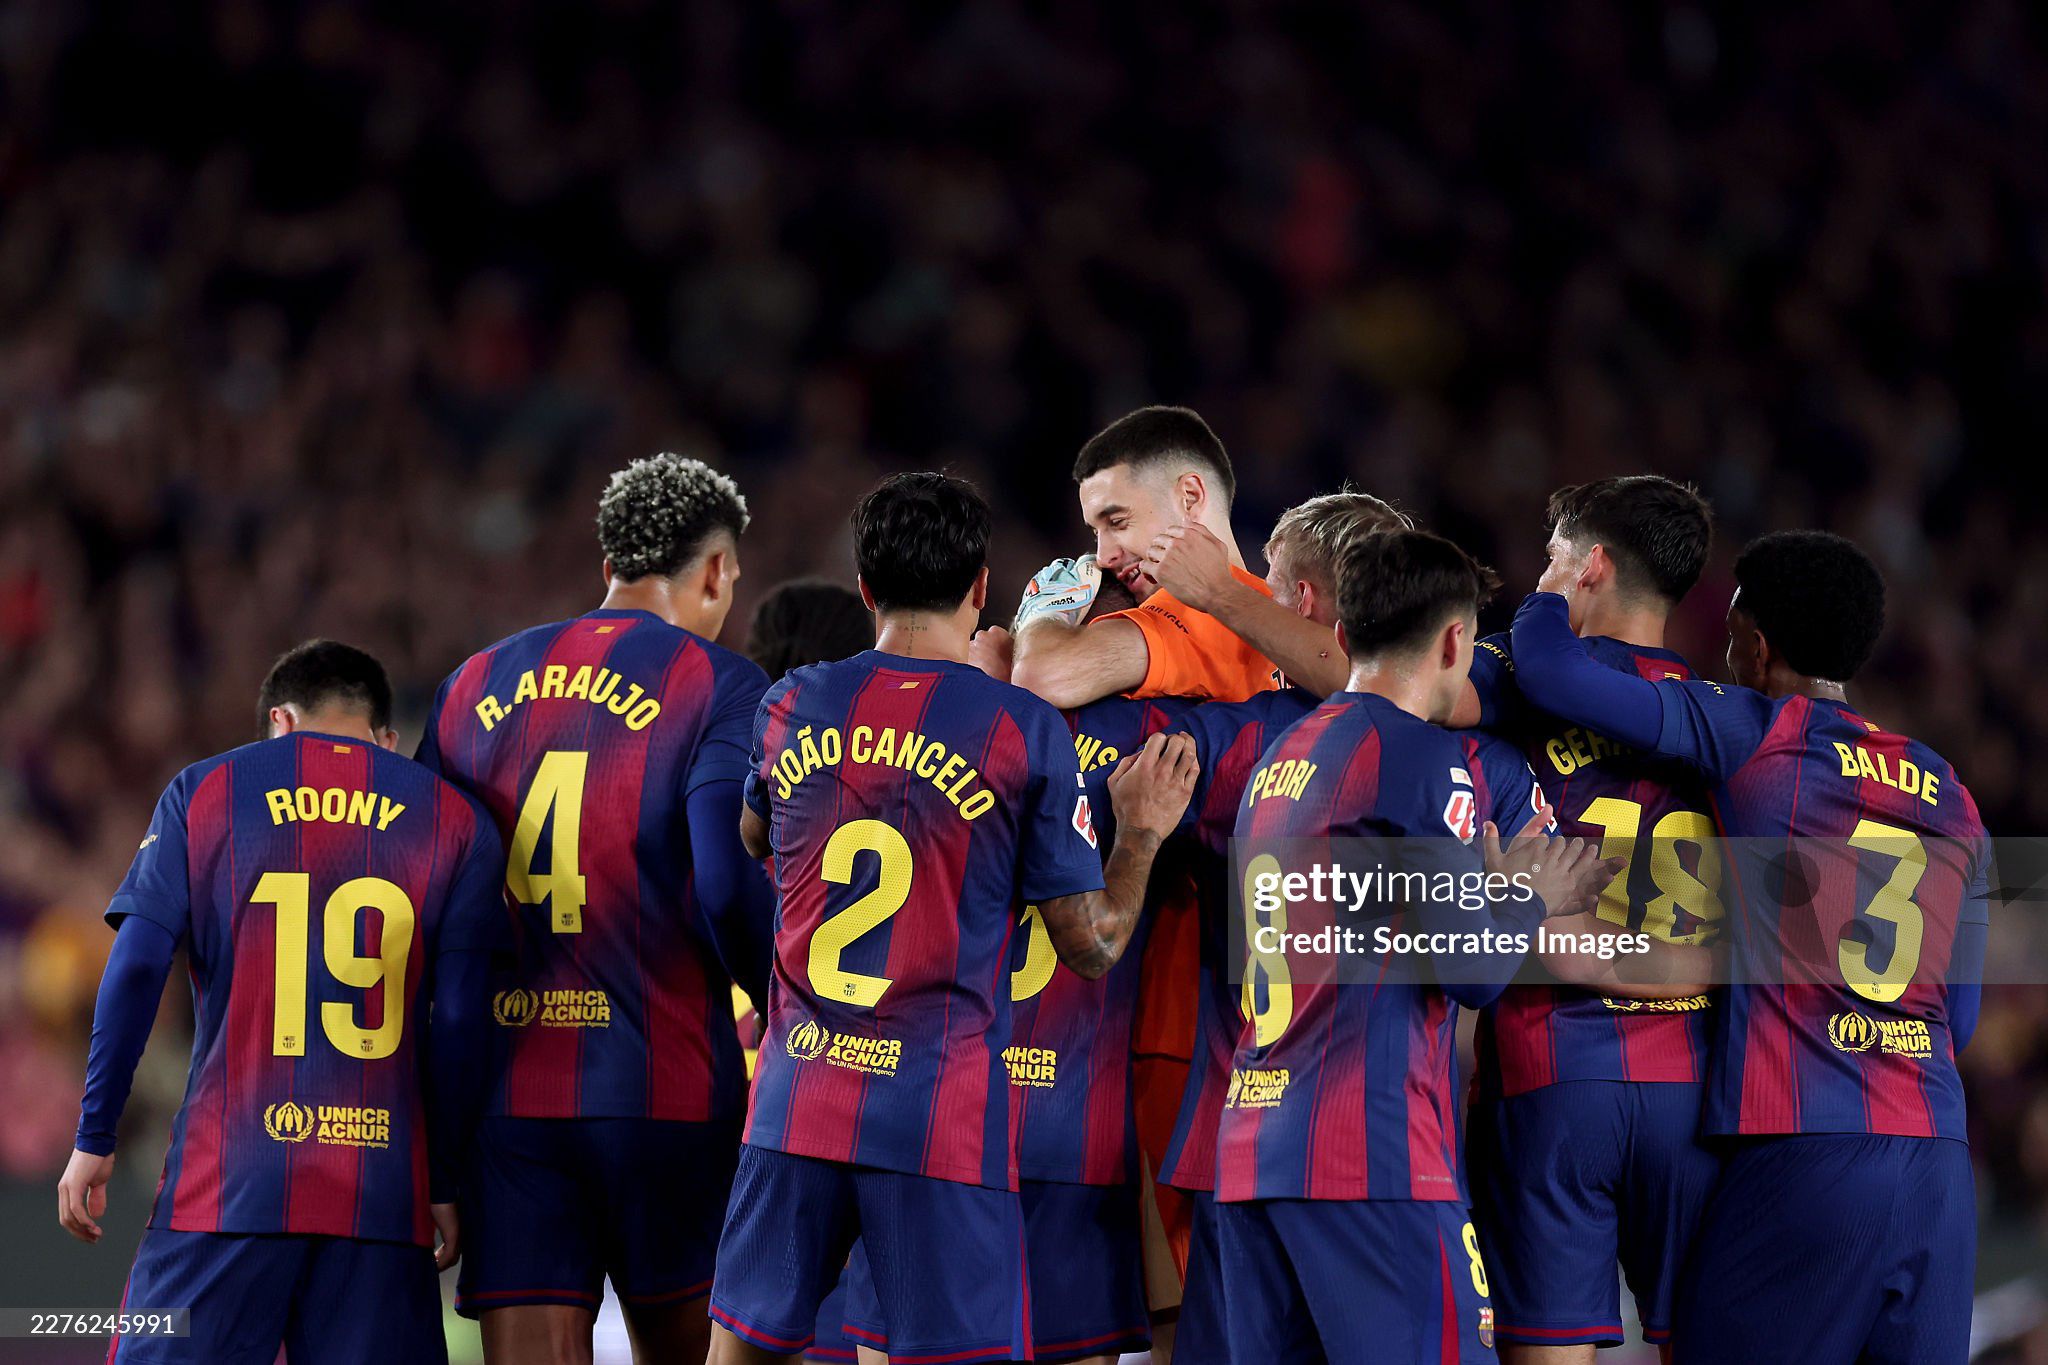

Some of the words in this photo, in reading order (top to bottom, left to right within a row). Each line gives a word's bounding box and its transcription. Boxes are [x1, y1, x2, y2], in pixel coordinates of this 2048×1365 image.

[475, 664, 661, 732] R.ARAUJO
[771, 725, 842, 800] JOÃO
[850, 725, 996, 822] CANCELO
[1249, 759, 1317, 807] PEDRI
[1832, 741, 1940, 806] BALDE
[265, 786, 406, 831] ROONY
[507, 750, 589, 934] 4
[1578, 797, 1722, 947] 18
[806, 818, 914, 1008] 2
[1838, 818, 1929, 1003] 3
[249, 871, 415, 1060] 19
[1241, 853, 1294, 1048] 8
[540, 1005, 611, 1021] ACNUR
[543, 990, 609, 1006] UNHCR
[826, 1045, 900, 1070] ACNUR
[833, 1033, 902, 1056] UNHCR
[847, 1063, 871, 1072] Refugee
[872, 1067, 896, 1077] Agency
[1243, 1069, 1290, 1087] UNHCR
[316, 1122, 389, 1141] ACNUR
[318, 1106, 390, 1126] UNHCR
[1461, 1222, 1490, 1298] 8
